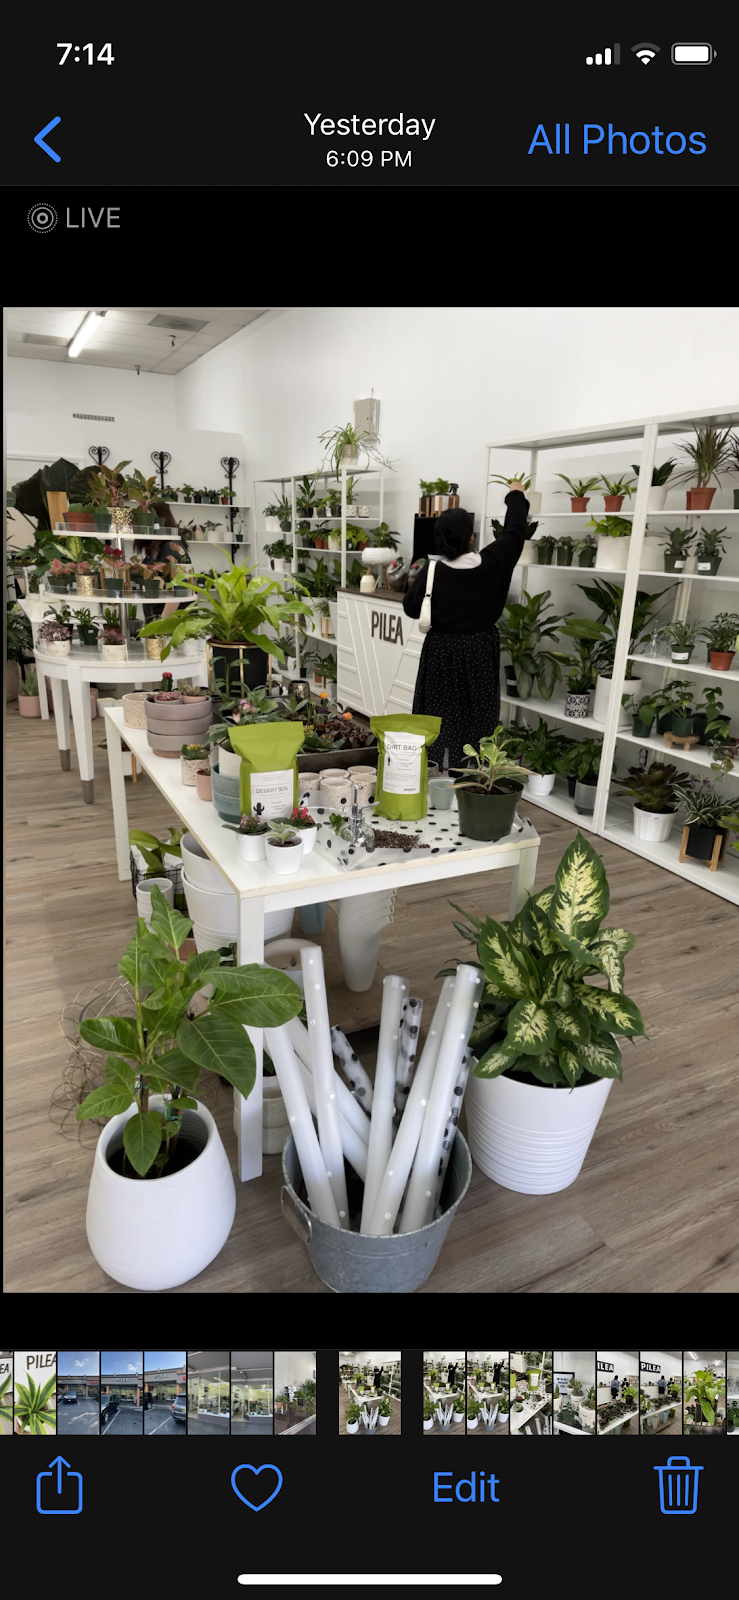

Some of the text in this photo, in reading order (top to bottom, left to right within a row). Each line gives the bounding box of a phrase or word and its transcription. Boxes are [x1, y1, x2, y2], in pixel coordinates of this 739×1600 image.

[56, 42, 116, 66] 7:14
[303, 112, 437, 141] Yesterday
[527, 123, 707, 155] All Photos
[326, 149, 412, 168] 6:09 PM
[66, 207, 121, 229] LIVE
[372, 611, 403, 645] PILEA
[641, 1362, 661, 1372] PILEA
[433, 1470, 500, 1503] Edit
